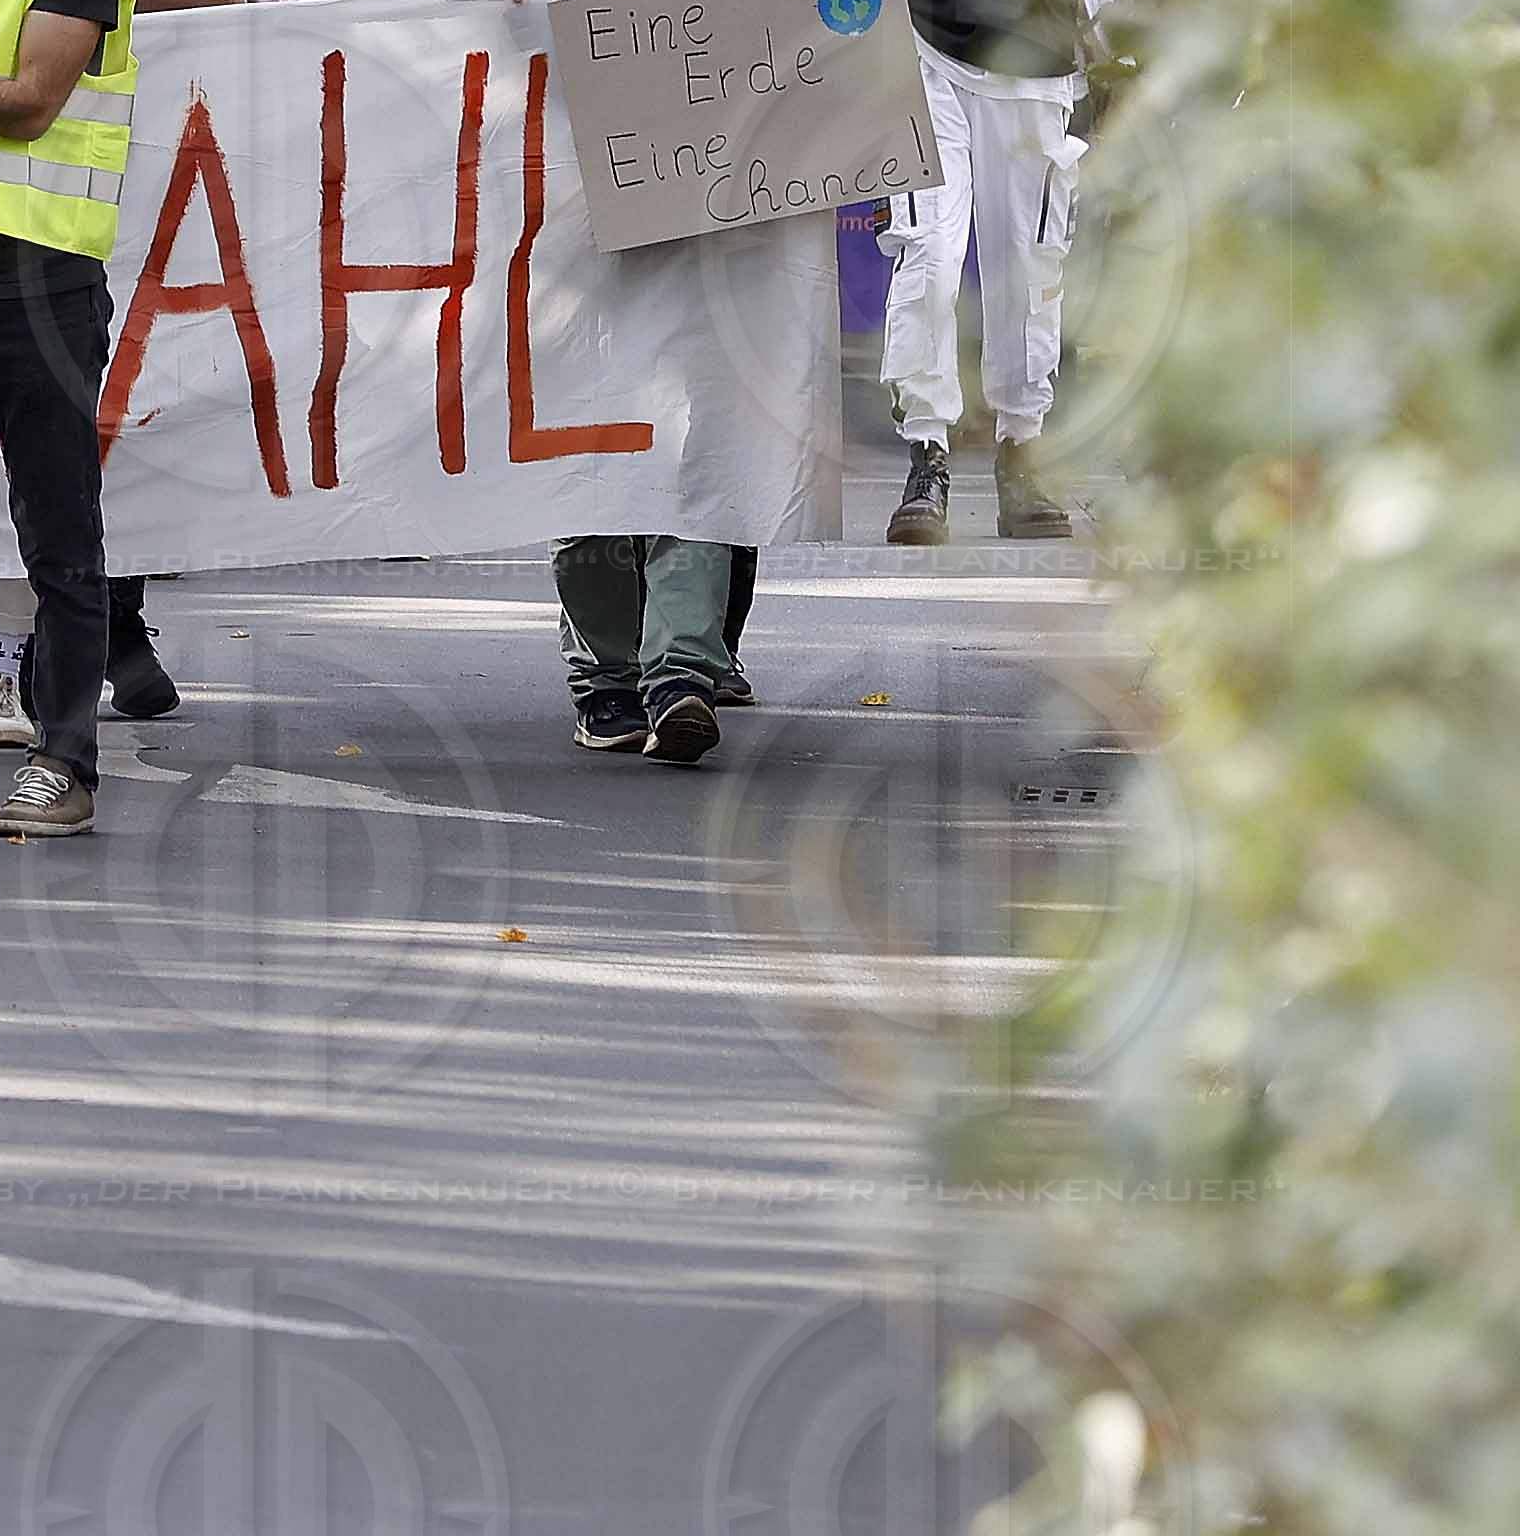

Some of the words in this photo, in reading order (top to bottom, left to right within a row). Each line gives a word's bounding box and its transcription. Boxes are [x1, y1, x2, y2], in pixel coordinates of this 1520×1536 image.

[585, 3, 713, 61] Eine
[684, 27, 824, 105] Erde
[605, 132, 732, 190] Eine
